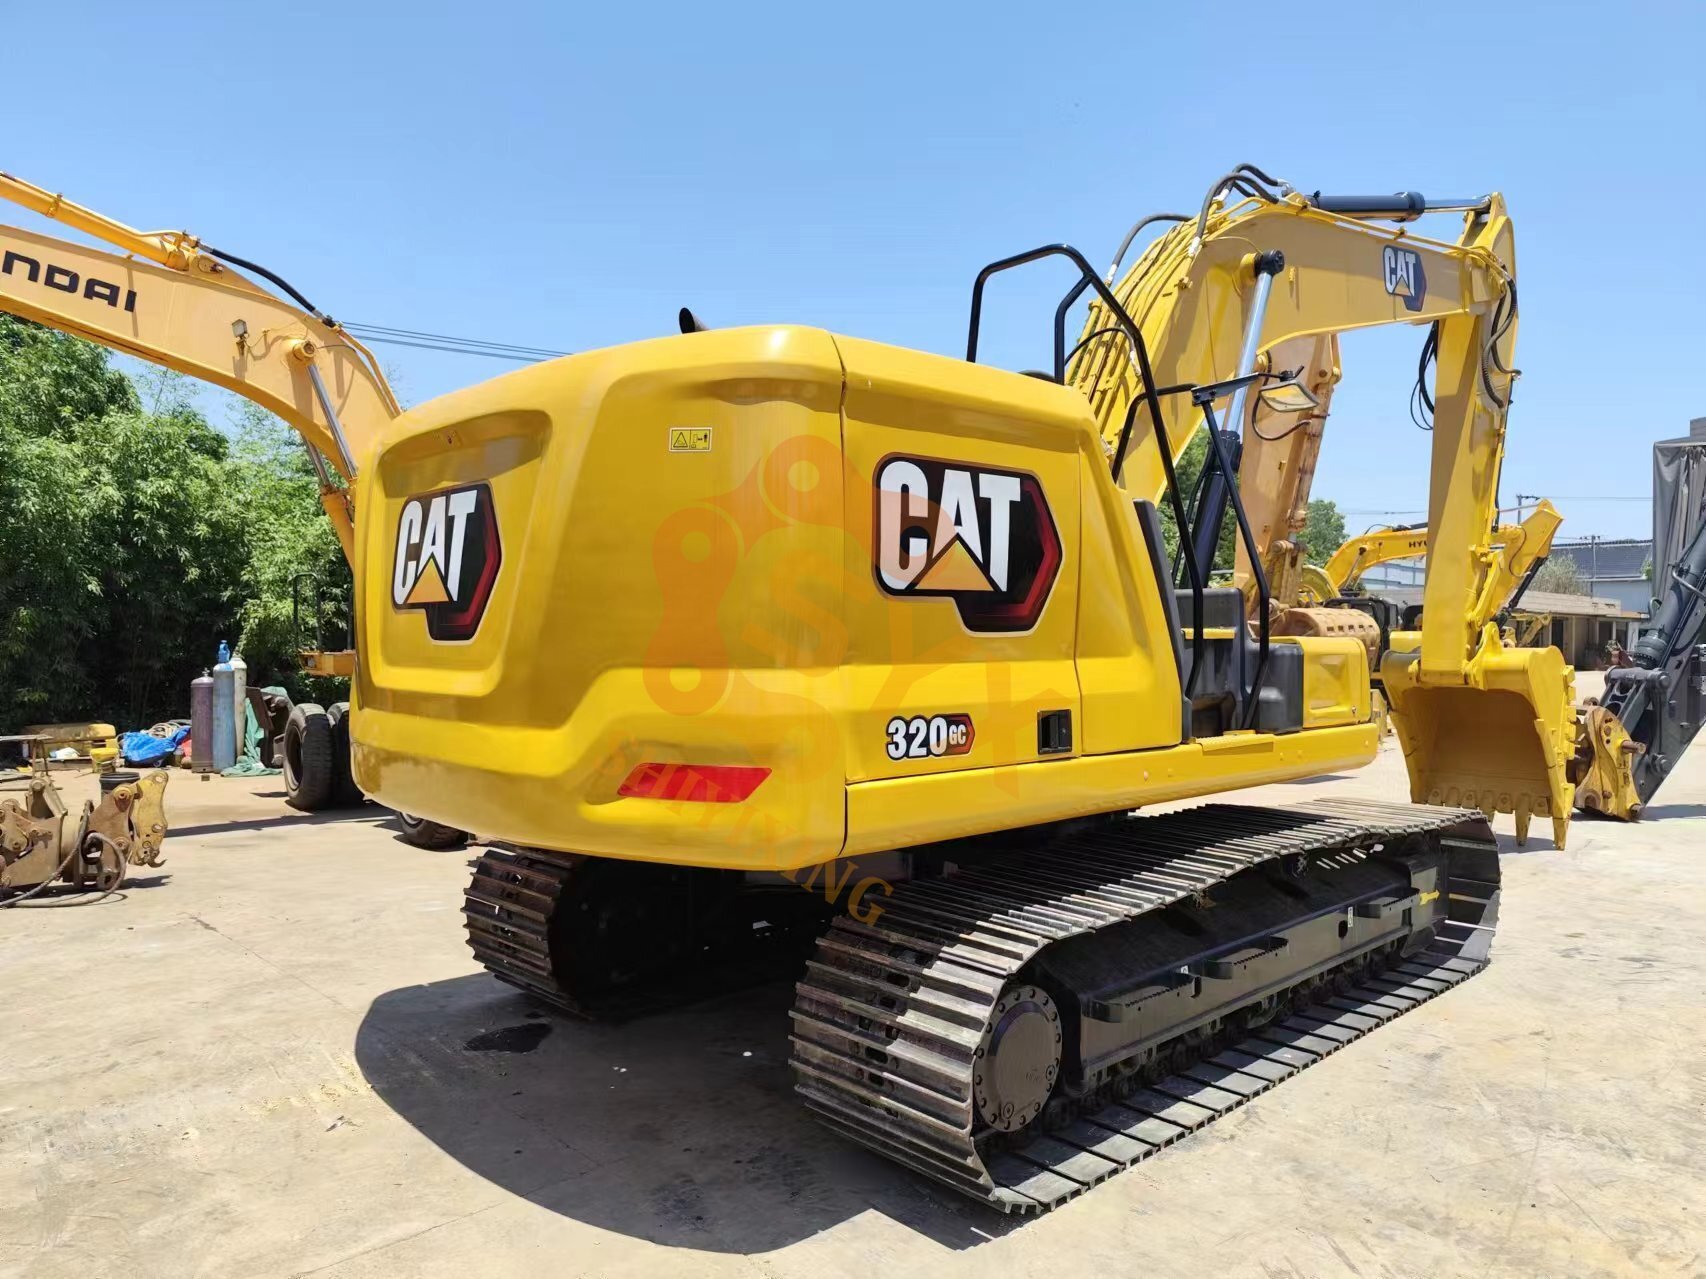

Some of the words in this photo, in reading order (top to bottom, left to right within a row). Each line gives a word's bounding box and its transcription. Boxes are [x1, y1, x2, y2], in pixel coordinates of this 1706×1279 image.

[1384, 247, 1417, 297] CAT
[393, 489, 478, 606] CAT
[879, 461, 1021, 592] CAT
